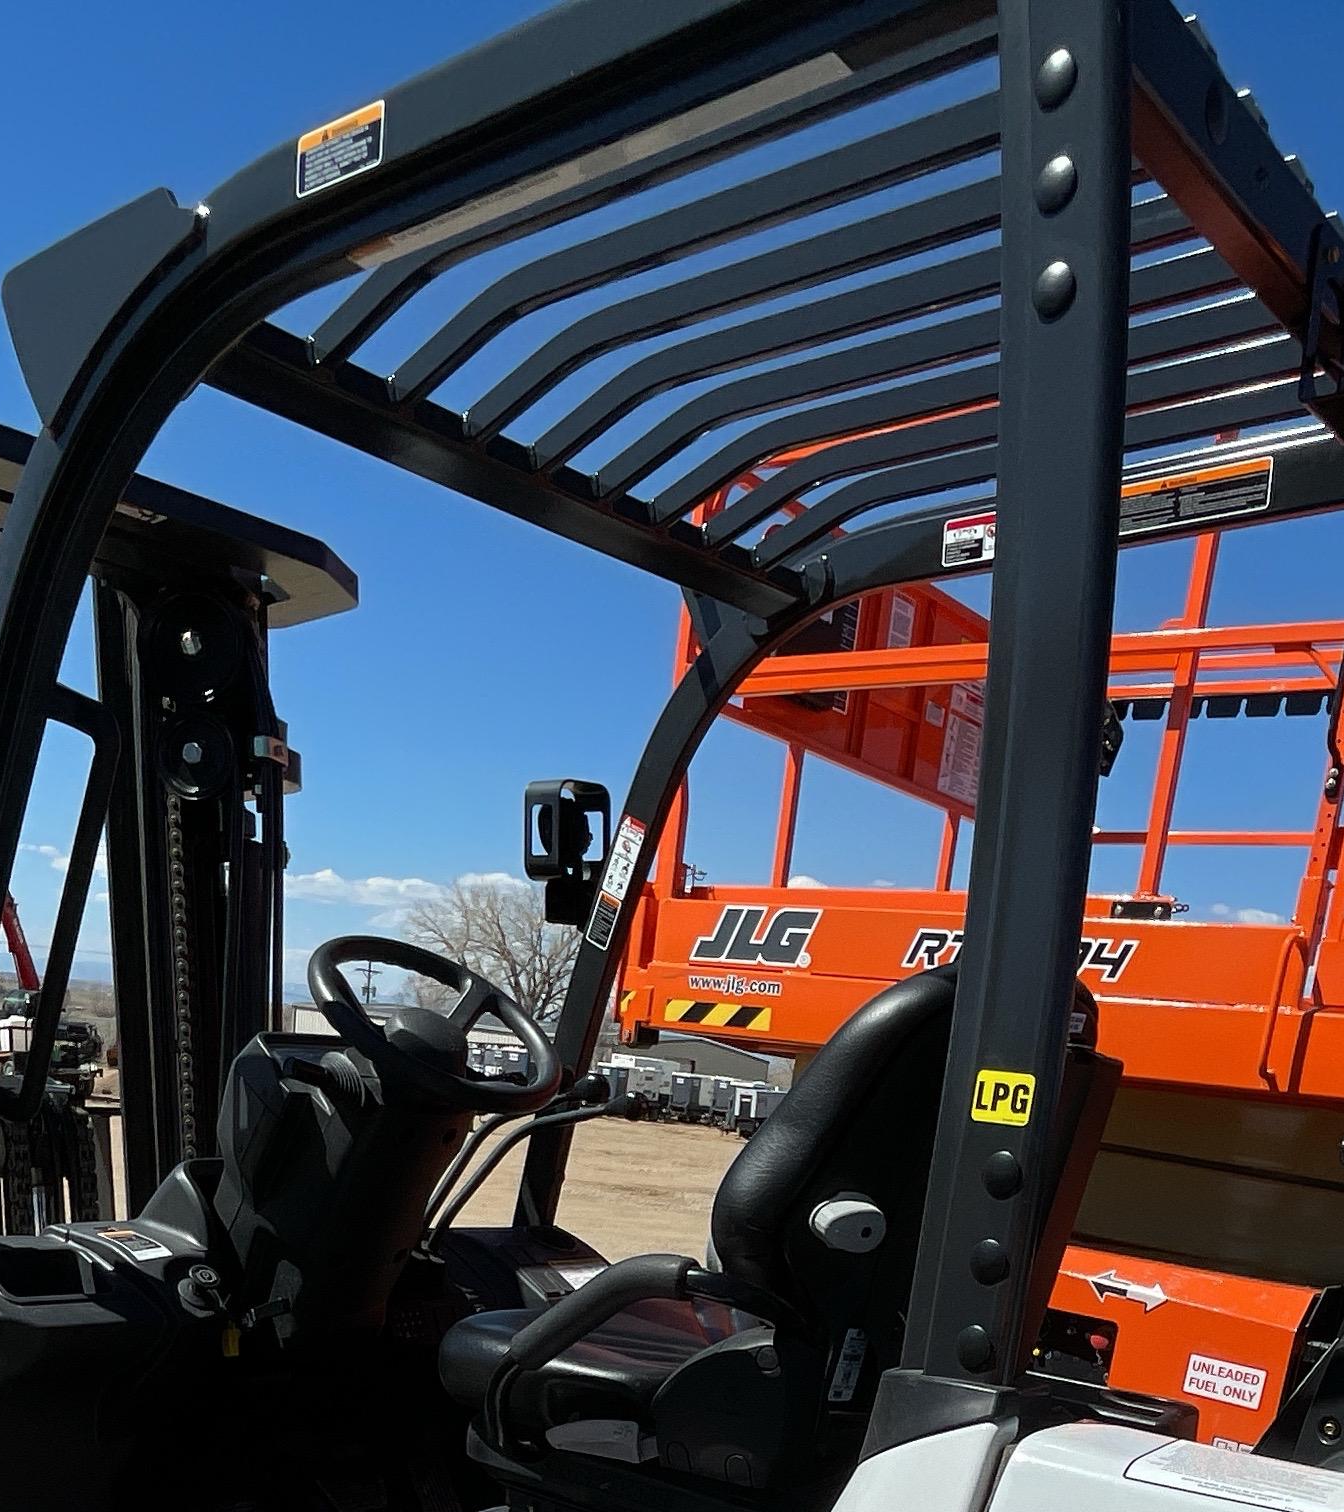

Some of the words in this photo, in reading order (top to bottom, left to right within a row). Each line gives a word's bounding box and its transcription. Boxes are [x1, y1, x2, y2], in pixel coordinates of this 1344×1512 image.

[690, 905, 823, 967] JLG
[689, 976, 783, 996] www.jlg.com
[976, 1081, 1031, 1114] LPG
[1192, 1360, 1260, 1386] UNLEADED
[1188, 1377, 1219, 1394] FUEL
[1223, 1386, 1257, 1403] ONLY
